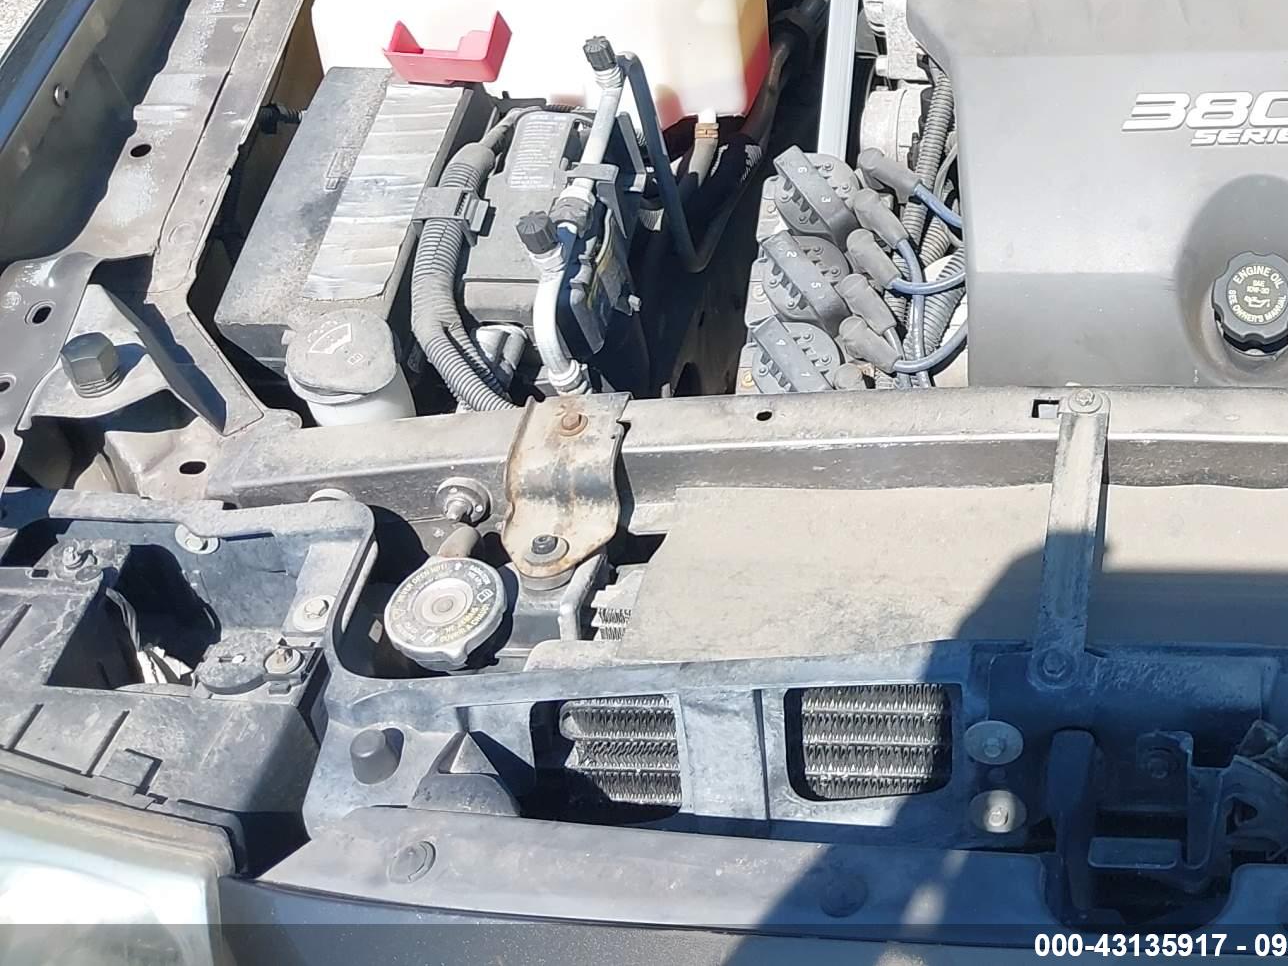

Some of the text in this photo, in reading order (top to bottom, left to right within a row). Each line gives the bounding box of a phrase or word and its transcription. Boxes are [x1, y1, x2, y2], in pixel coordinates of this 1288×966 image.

[1233, 265, 1285, 290] ENGINE OIL
[1228, 289, 1287, 323] SEE OWNER'S MANUAL
